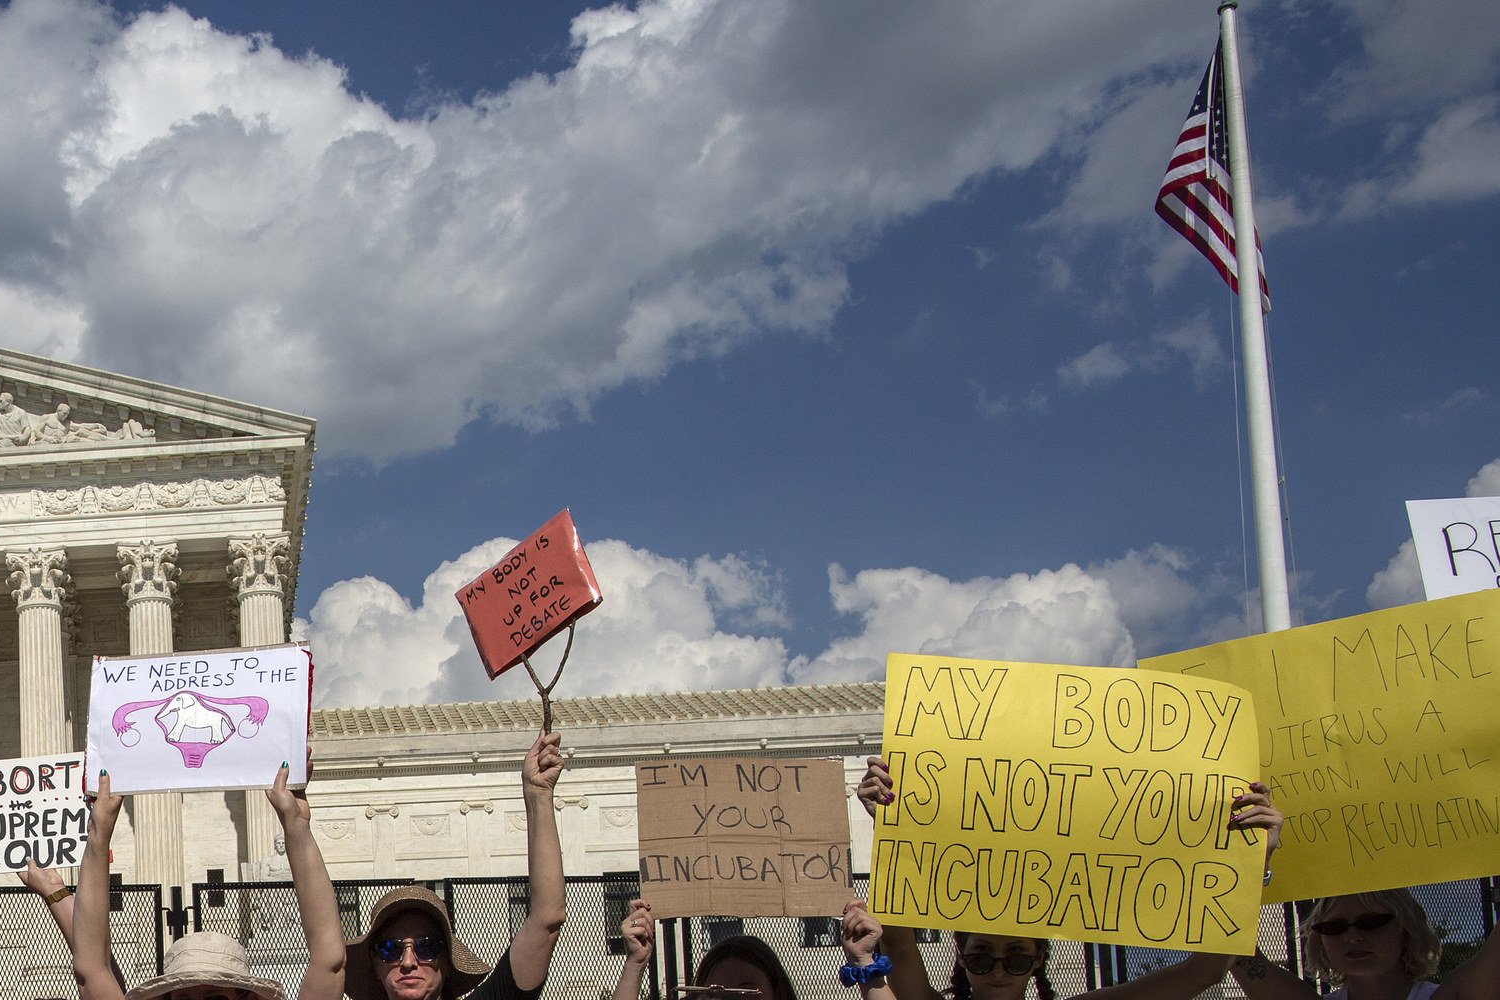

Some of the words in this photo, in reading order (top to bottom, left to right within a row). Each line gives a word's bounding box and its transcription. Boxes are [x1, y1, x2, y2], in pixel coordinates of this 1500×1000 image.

[466, 579, 486, 605] MY
[492, 550, 528, 583] BODY
[535, 534, 550, 550] IS
[507, 566, 538, 600] NOT
[503, 602, 523, 627] UP
[528, 575, 564, 607] FOR
[510, 594, 571, 648] DEBATE
[104, 665, 137, 686] WE
[149, 660, 210, 679] NEED
[230, 656, 260, 671] TO
[1333, 616, 1492, 701] MAKE
[151, 672, 235, 693] ADDRESS
[256, 666, 298, 685] THE
[894, 666, 1008, 741] MY
[1052, 673, 1241, 761] BODY
[1415, 700, 1446, 733] A
[641, 764, 708, 787] I'M
[736, 764, 807, 793] NOT
[1383, 748, 1490, 783] WILL
[8, 799, 33, 812] the
[692, 803, 793, 836] YOUR
[882, 750, 948, 828] IS
[961, 757, 1094, 837] NOT
[1098, 767, 1260, 851] YOUR
[1274, 807, 1332, 850] TOP
[646, 845, 846, 883] INCUBATOR
[872, 840, 1241, 946] INCUBATOR
